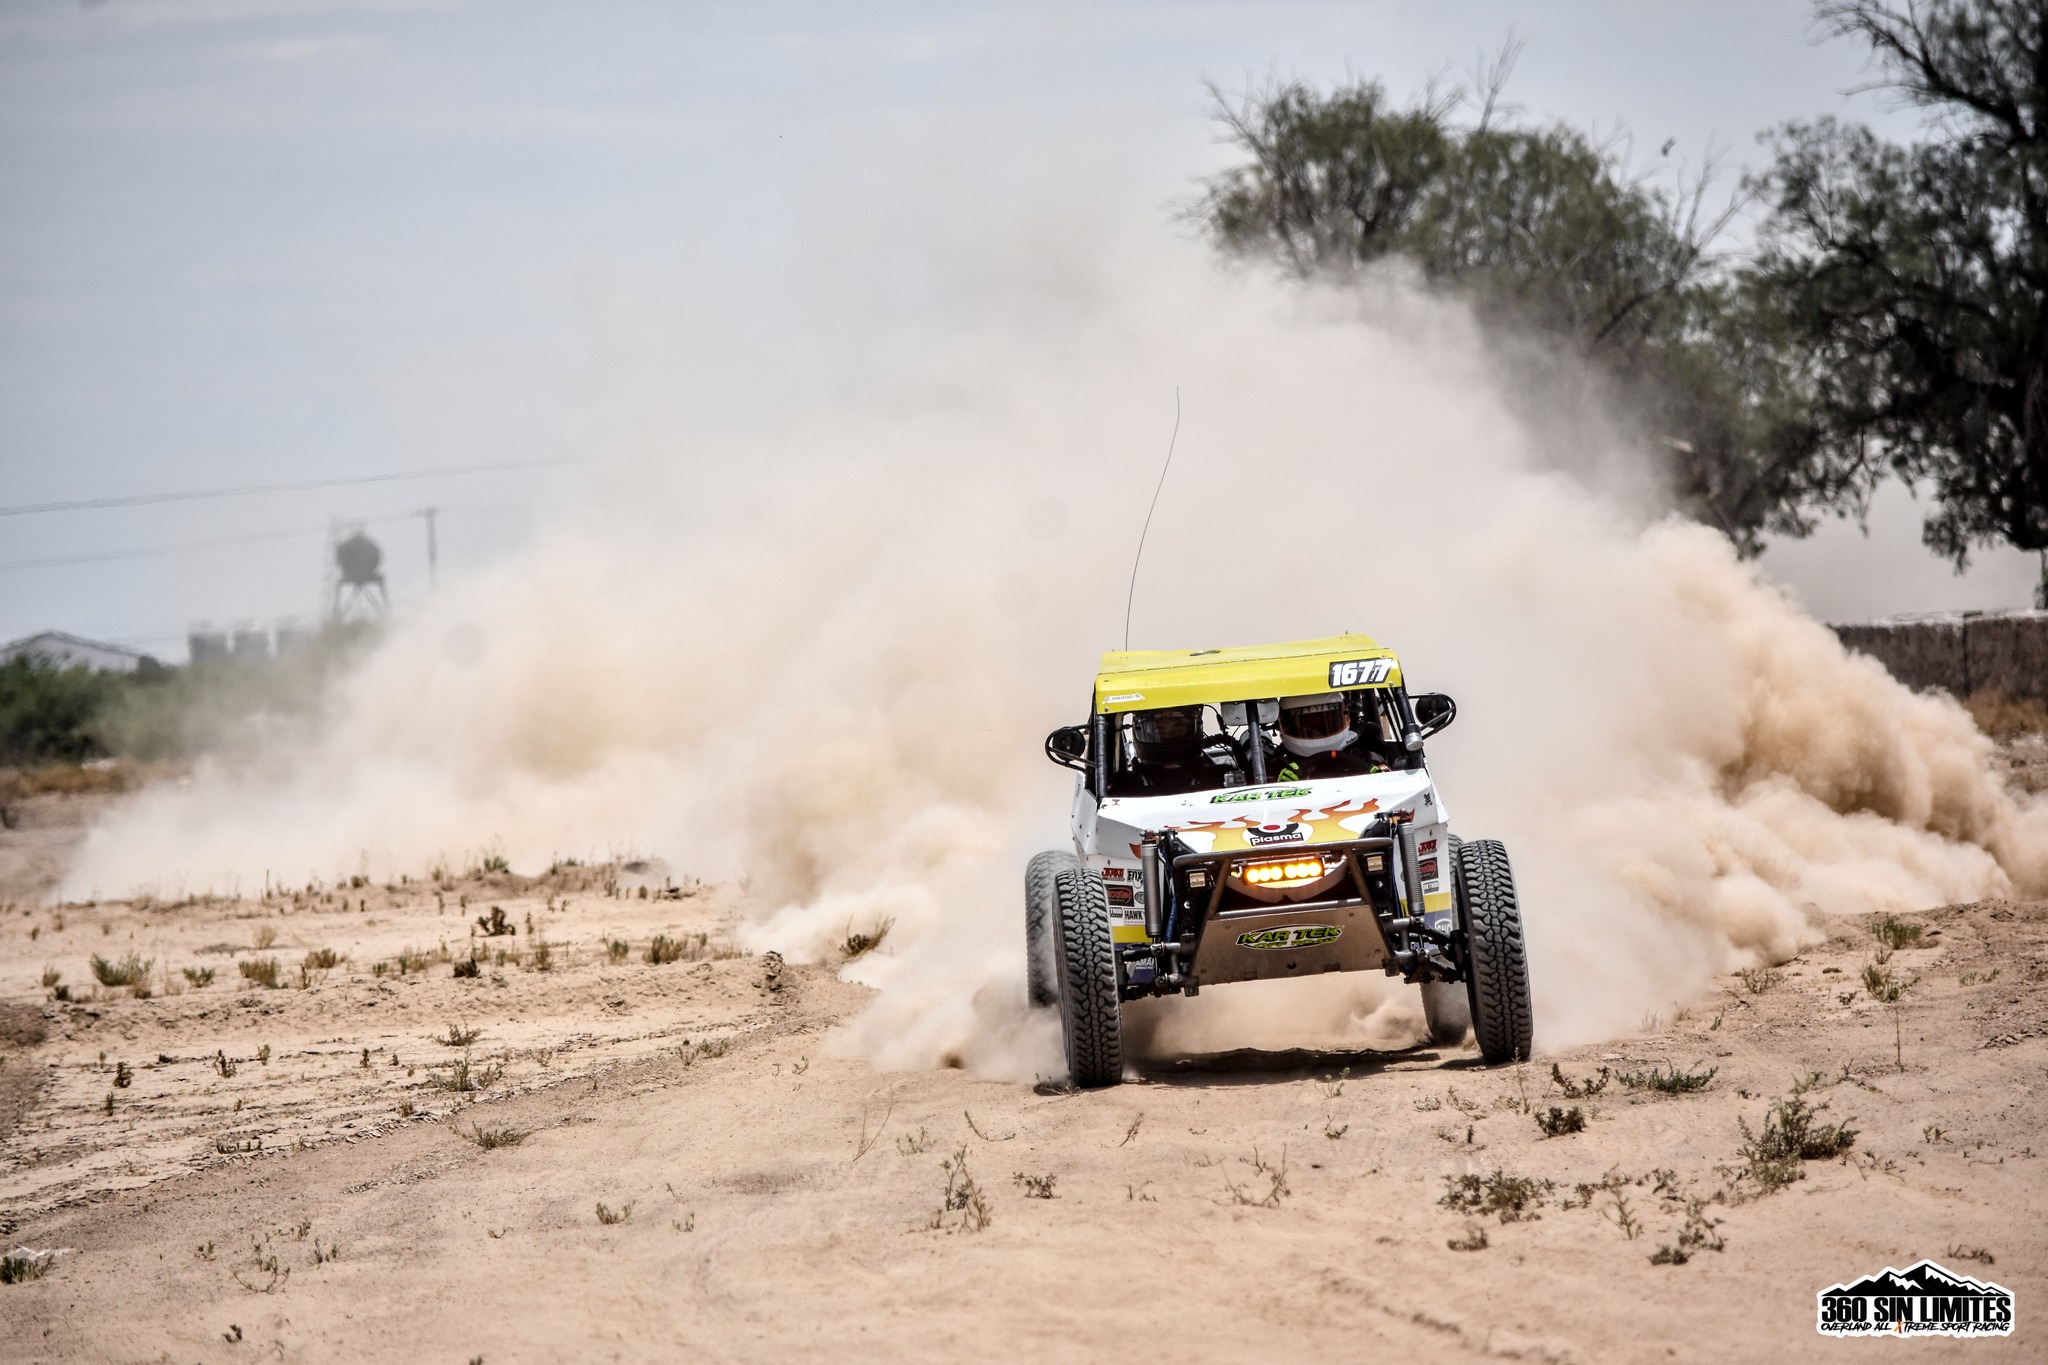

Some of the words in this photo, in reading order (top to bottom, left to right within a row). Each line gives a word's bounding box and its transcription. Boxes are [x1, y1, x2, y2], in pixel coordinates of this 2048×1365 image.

[1332, 659, 1392, 687] 1677
[1210, 792, 1262, 804] KAR
[1265, 787, 1313, 799] TEK
[1252, 832, 1302, 845] plasma
[1127, 870, 1143, 881] FOX
[1238, 930, 1291, 944] KAR
[1293, 924, 1343, 940] TEK
